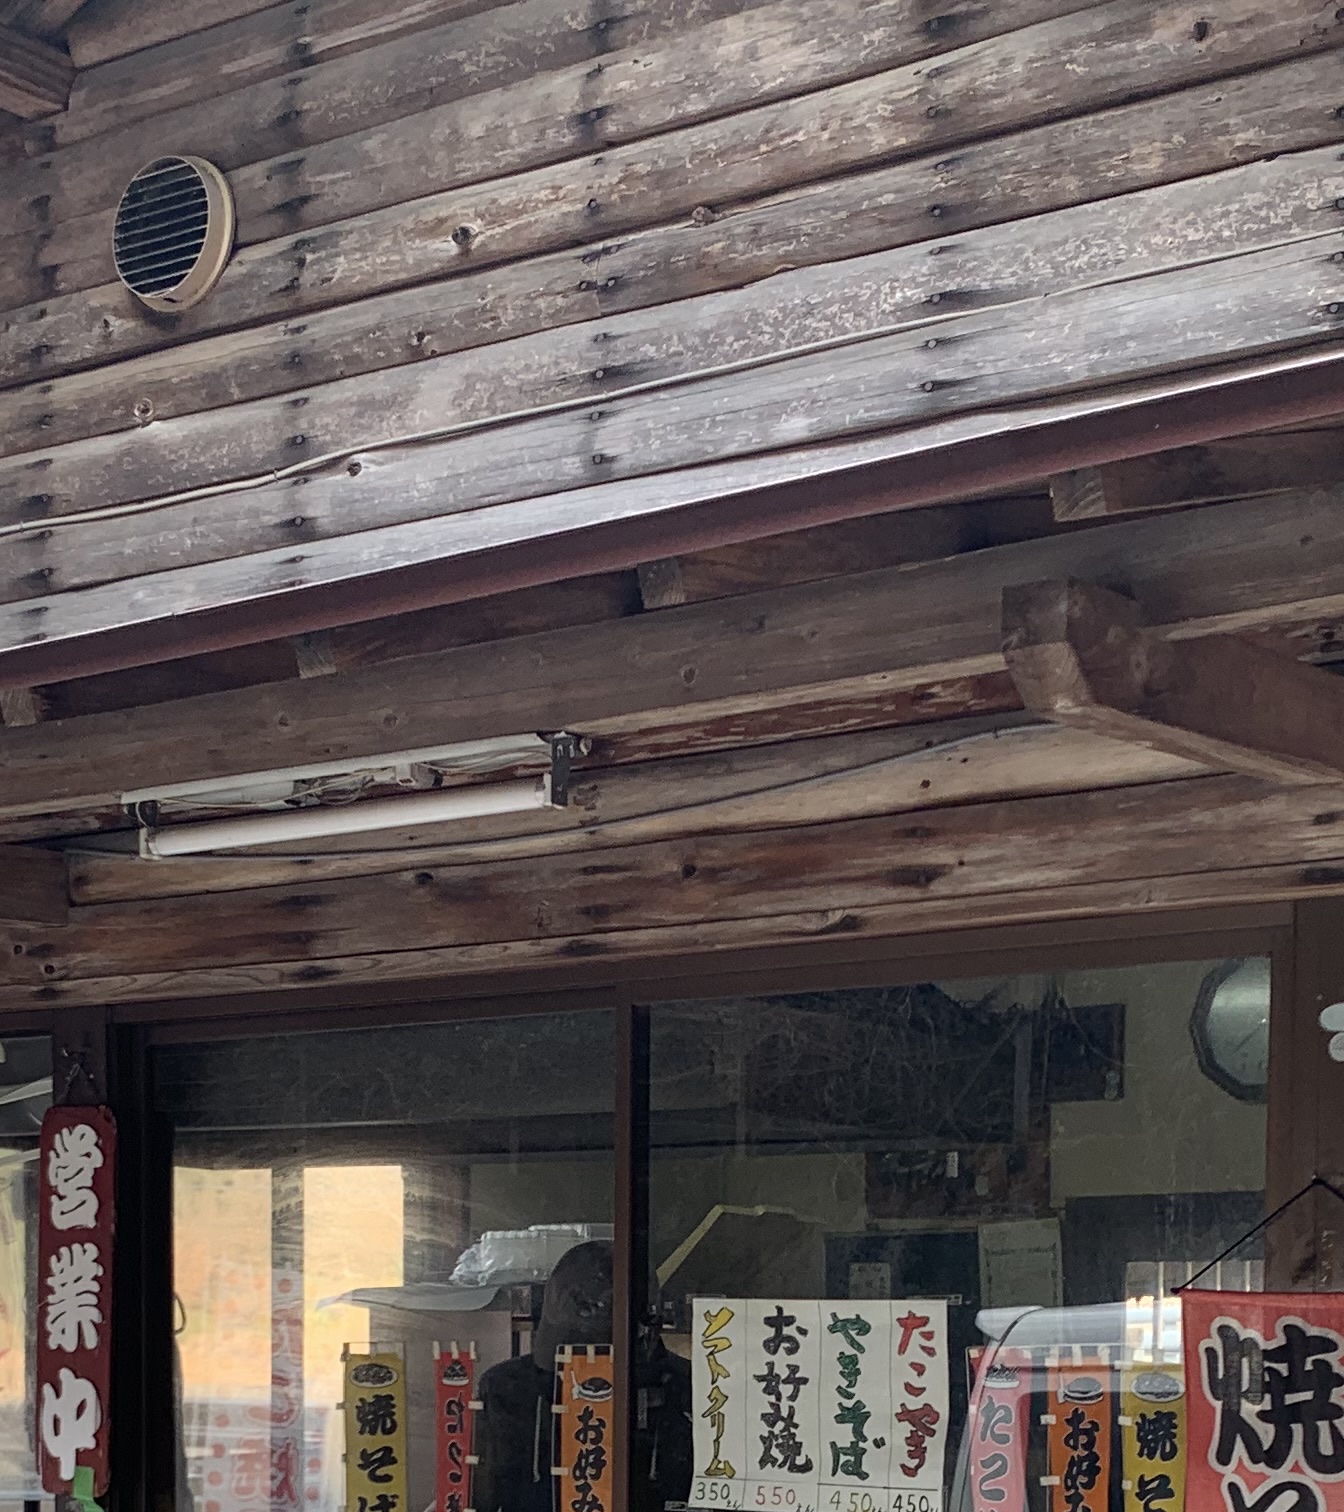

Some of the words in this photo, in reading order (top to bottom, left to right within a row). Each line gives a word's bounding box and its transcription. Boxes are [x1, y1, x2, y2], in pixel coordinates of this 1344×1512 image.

[42, 1124, 104, 1482] 営業中
[752, 1305, 814, 1474] お好み焼
[826, 1311, 887, 1481] やきそば
[895, 1309, 941, 1478] たこやき
